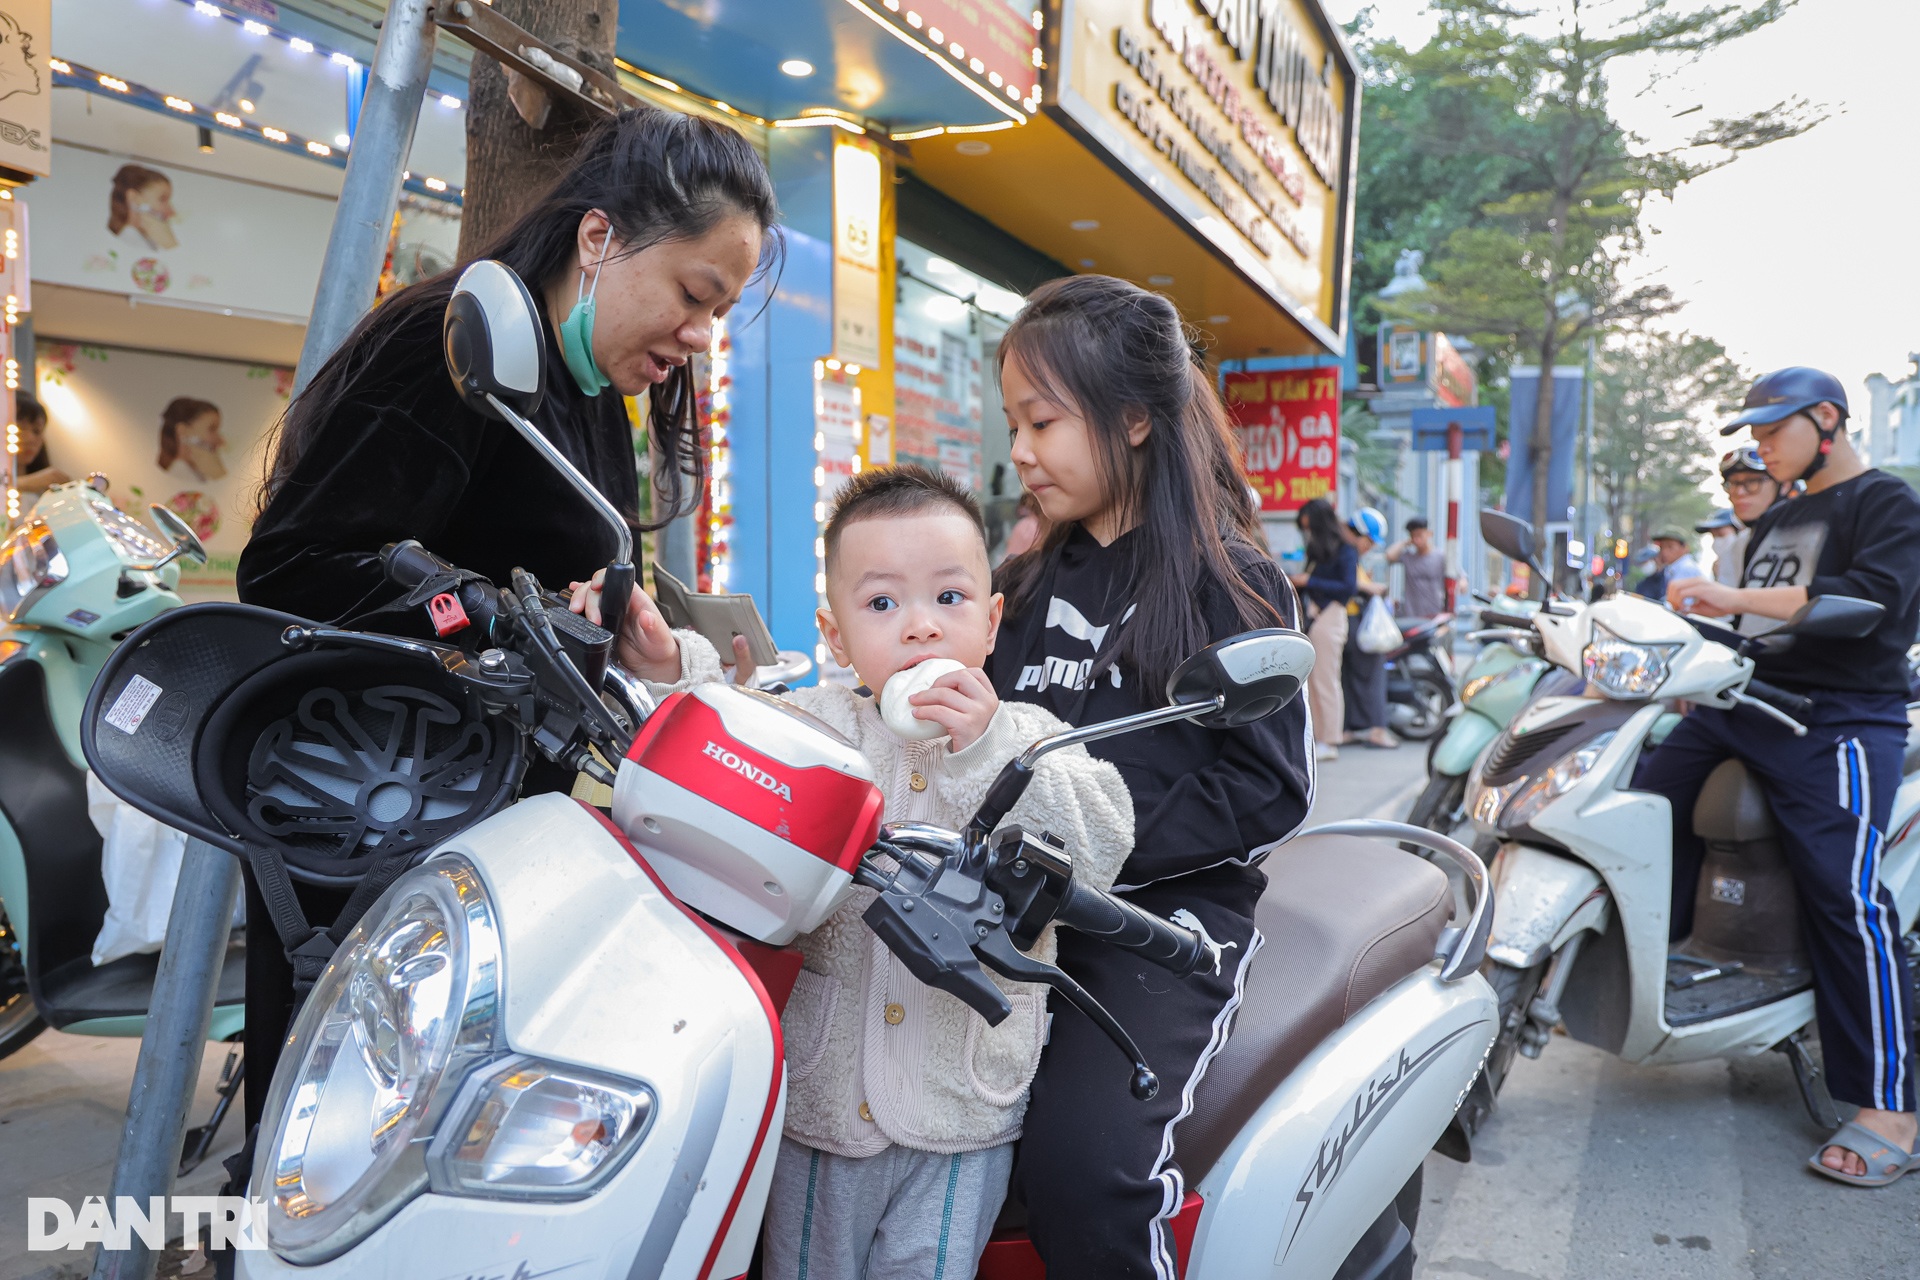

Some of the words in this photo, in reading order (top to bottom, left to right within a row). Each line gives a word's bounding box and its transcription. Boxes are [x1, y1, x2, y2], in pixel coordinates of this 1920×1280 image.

[1314, 376, 1335, 399] 71
[702, 741, 793, 803] HONDA
[1282, 1040, 1425, 1264] Stylish
